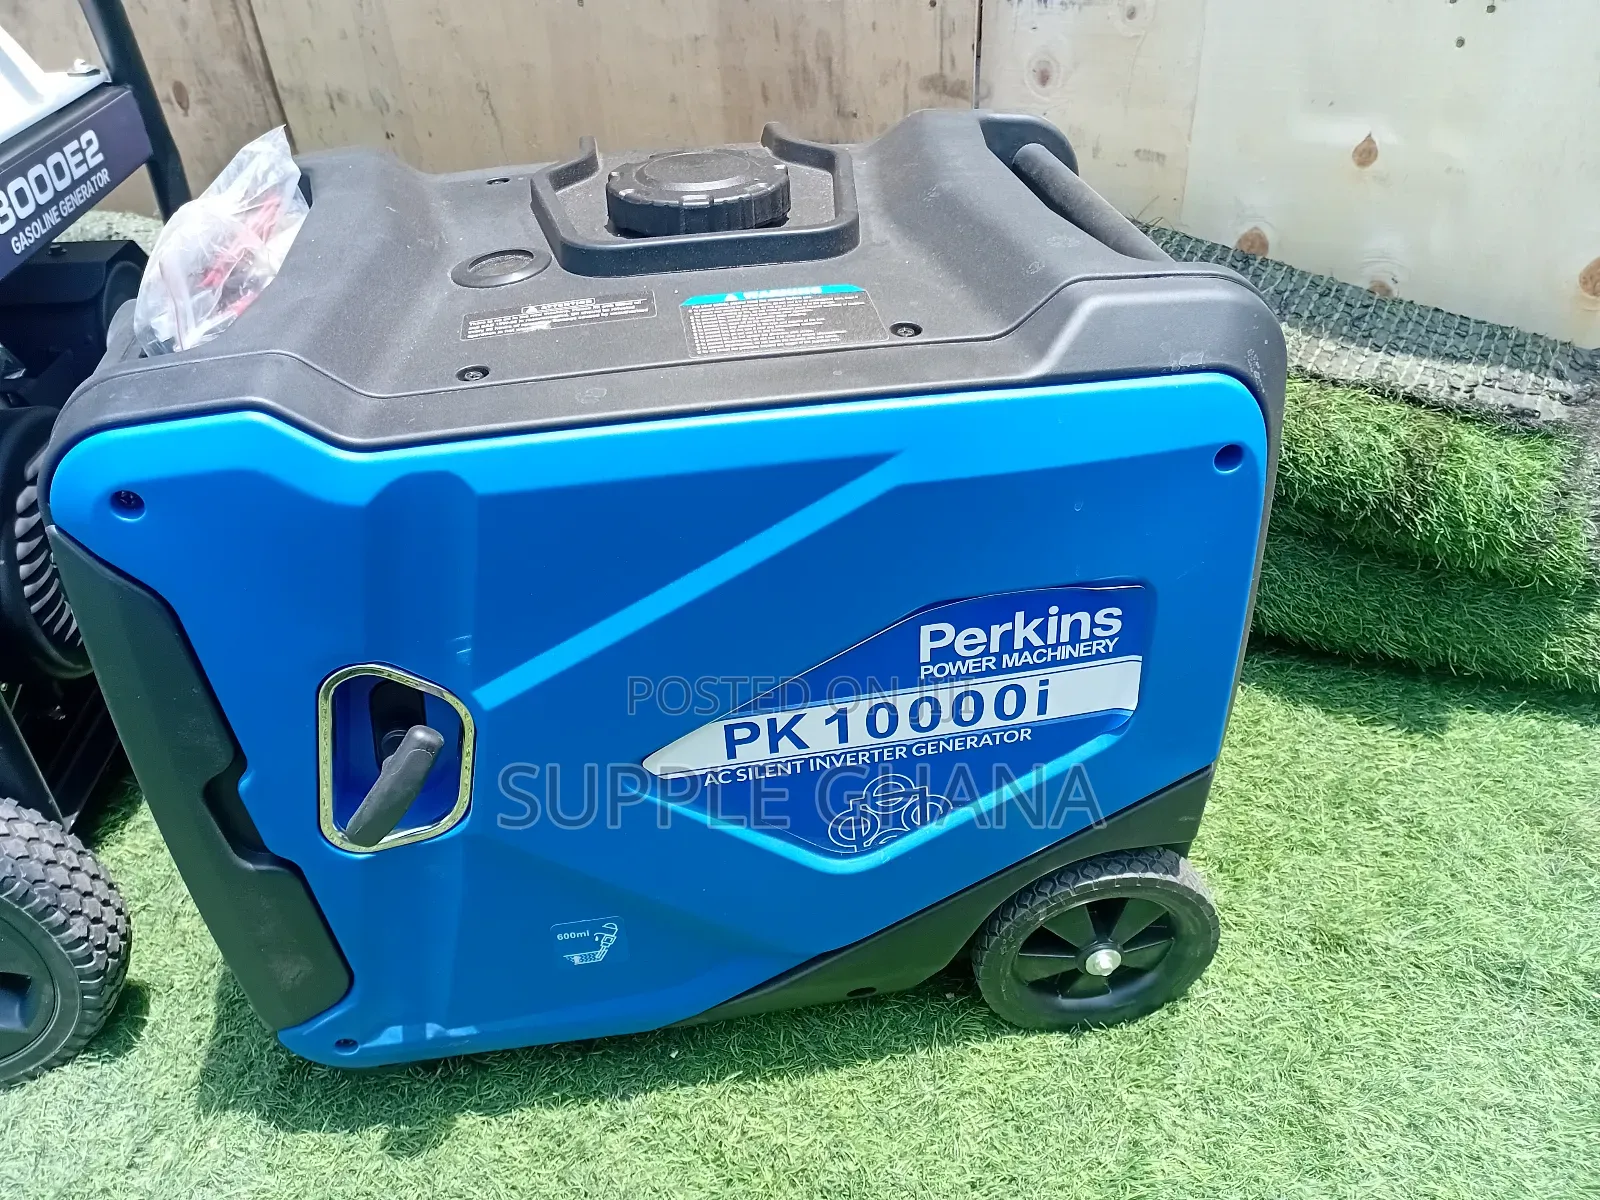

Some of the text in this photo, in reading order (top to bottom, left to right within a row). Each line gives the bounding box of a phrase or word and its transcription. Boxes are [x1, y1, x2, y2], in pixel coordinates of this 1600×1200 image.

[11, 168, 111, 254] GASOLINE GENERATOR
[919, 605, 1123, 663] Perkins
[920, 637, 1120, 680] POWER MACHINERY
[722, 678, 1051, 760] PK 10000i
[703, 727, 1033, 787] AC SILENT INVERTER GENERATOR
[556, 929, 590, 941] 600ml
